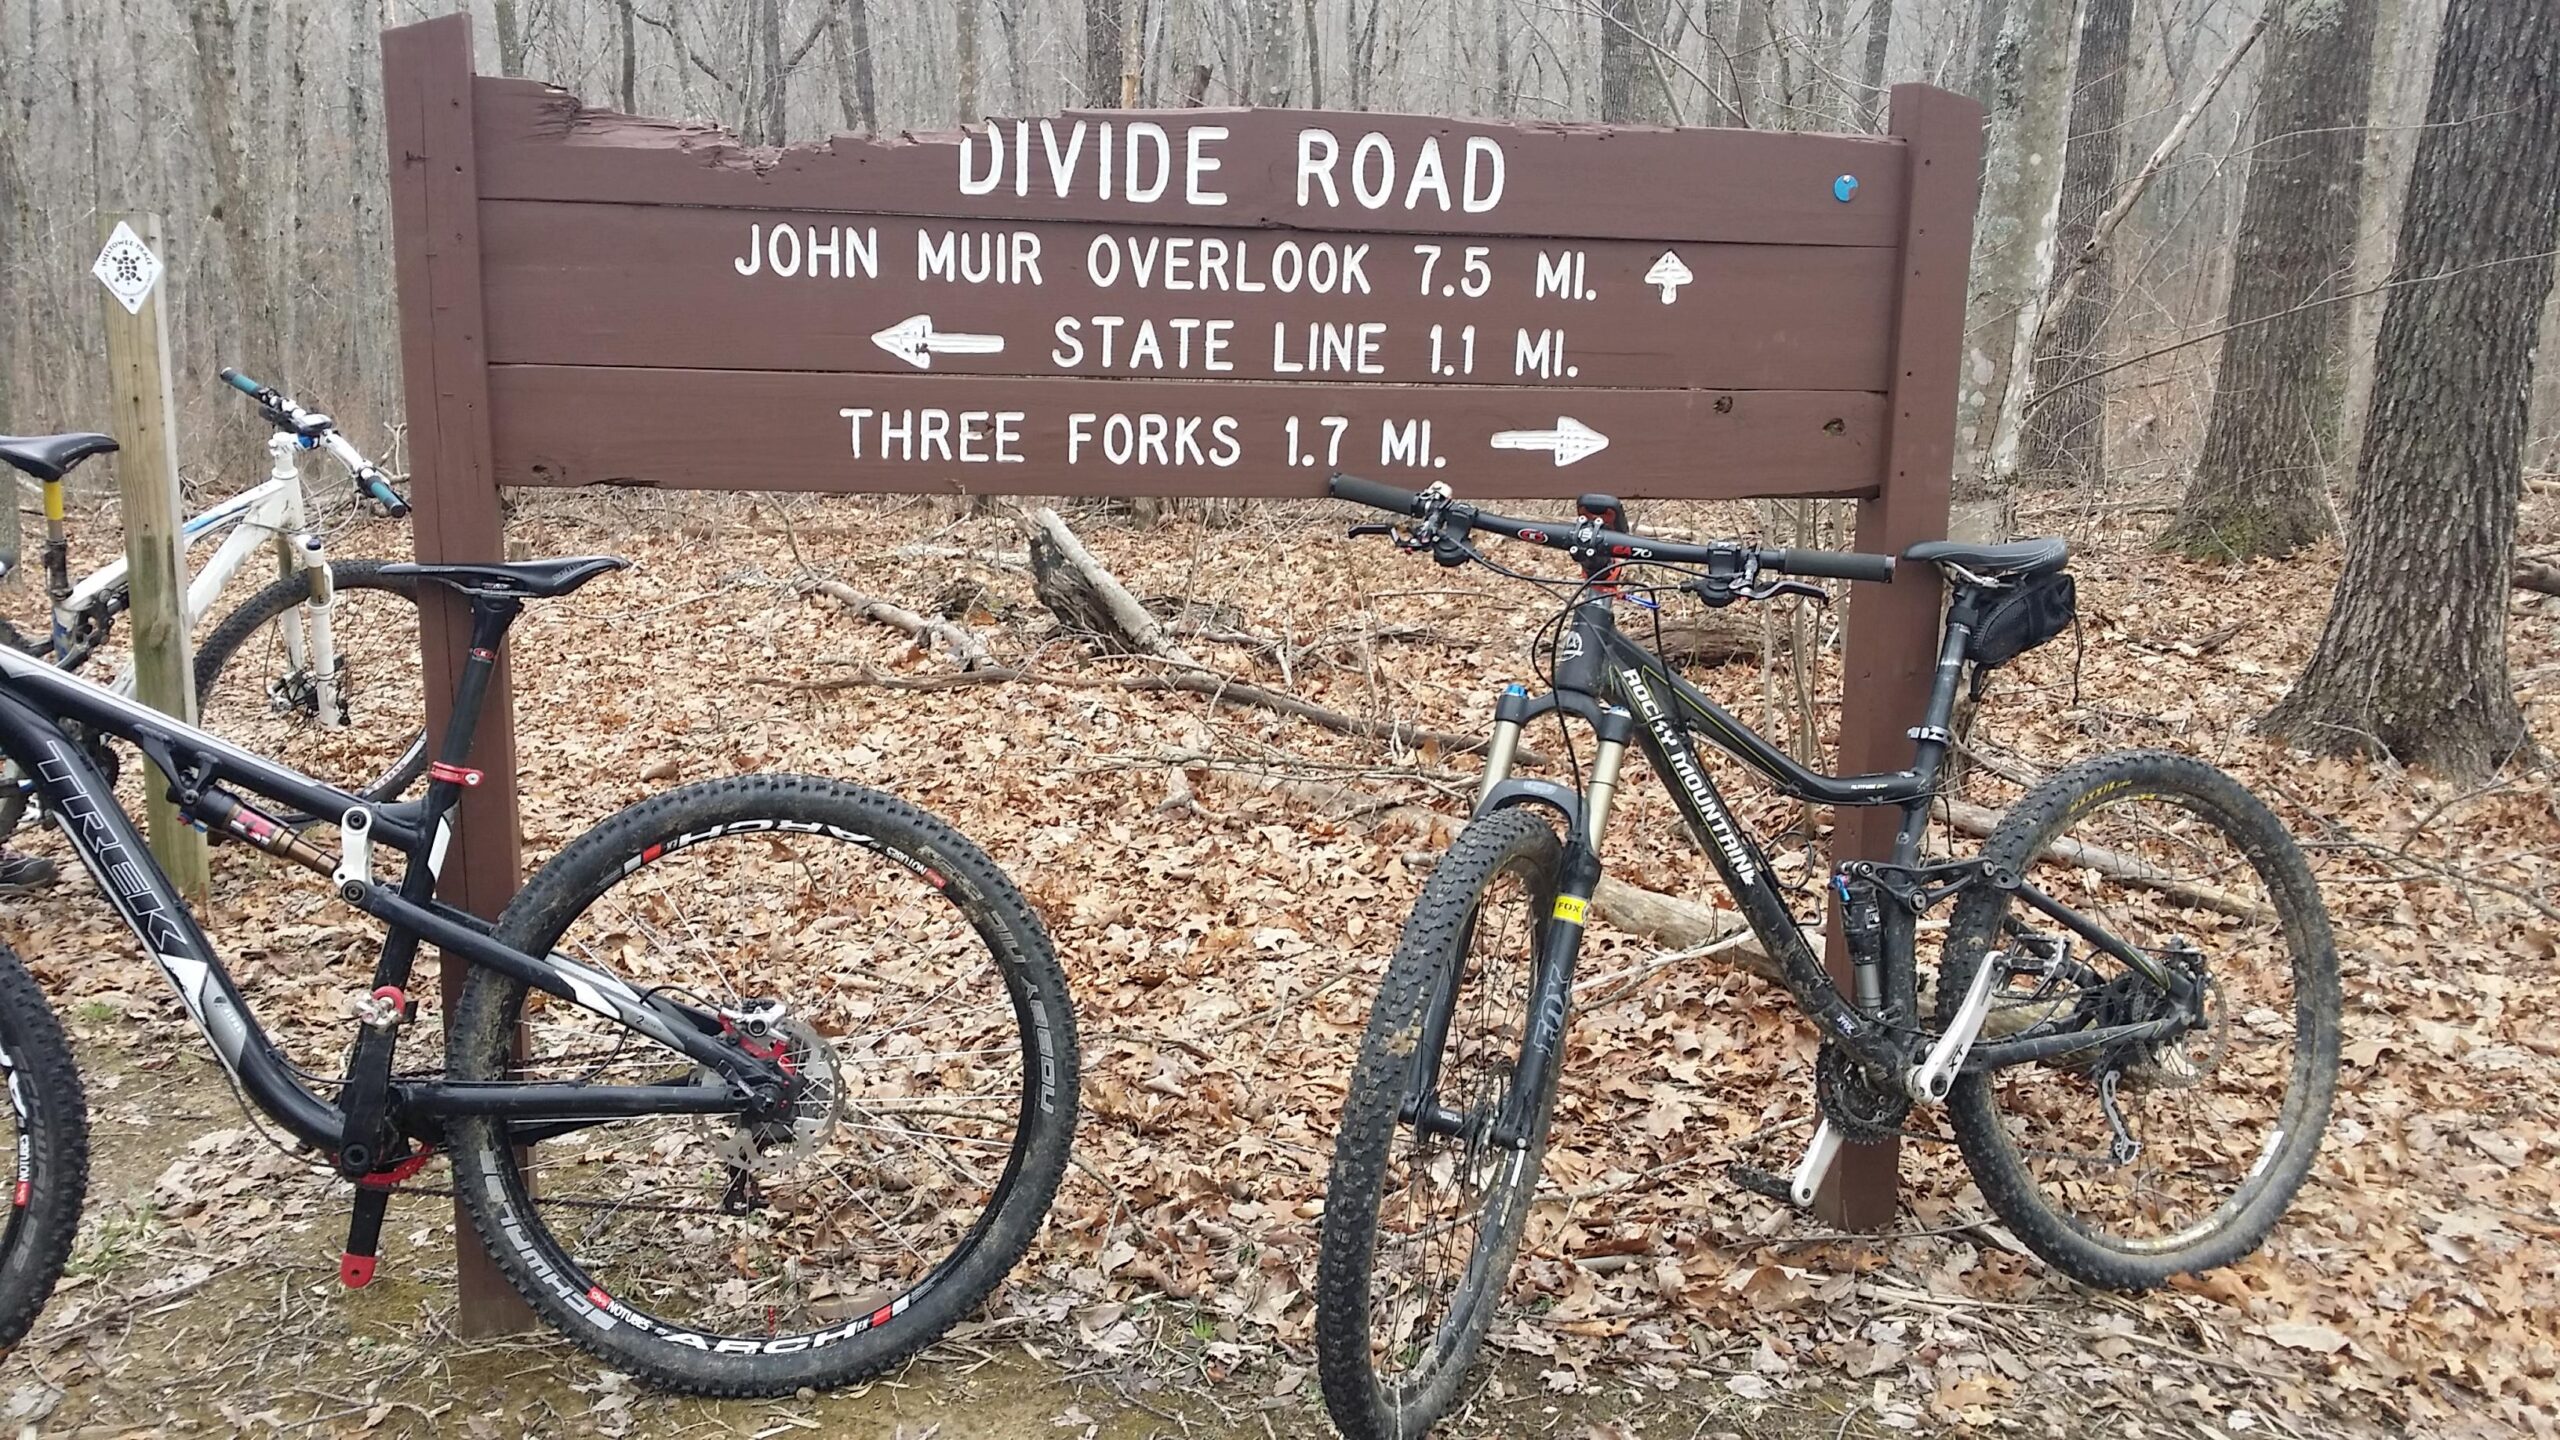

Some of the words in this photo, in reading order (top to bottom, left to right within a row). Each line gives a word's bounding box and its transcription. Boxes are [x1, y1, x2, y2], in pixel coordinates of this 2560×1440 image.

[959, 118, 1230, 206] DIVIDE
[1296, 128, 1507, 213] ROAD
[734, 222, 878, 279] JOHN
[917, 228, 1043, 286] MUIR
[1087, 233, 1372, 296] OVERLOOK
[1413, 244, 1493, 299] 7.5
[1535, 250, 1598, 301] MI.
[1051, 315, 1236, 372] STATE
[1273, 321, 1388, 375] LINE
[1429, 323, 1477, 377] 1.1
[1515, 327, 1580, 380] MI.
[839, 407, 1026, 464] THREE
[1068, 412, 1242, 468] FORKS
[1285, 415, 1350, 468] 1.7
[1380, 417, 1448, 470] MI.
[1621, 668, 1680, 747] ROCKY
[1671, 750, 1755, 876] MOUNTAIN
[37, 740, 188, 951] TREK
[679, 818, 875, 847] ARCH
[885, 846, 928, 876] NOTUBES
[1557, 901, 1581, 913] FOX
[1533, 959, 1574, 1058] FOX
[1019, 976, 1057, 1115] NOBBY
[18, 1134, 31, 1182] NOTUBES
[606, 1299, 654, 1332] NOTUBES
[660, 1321, 857, 1355] ARCH
